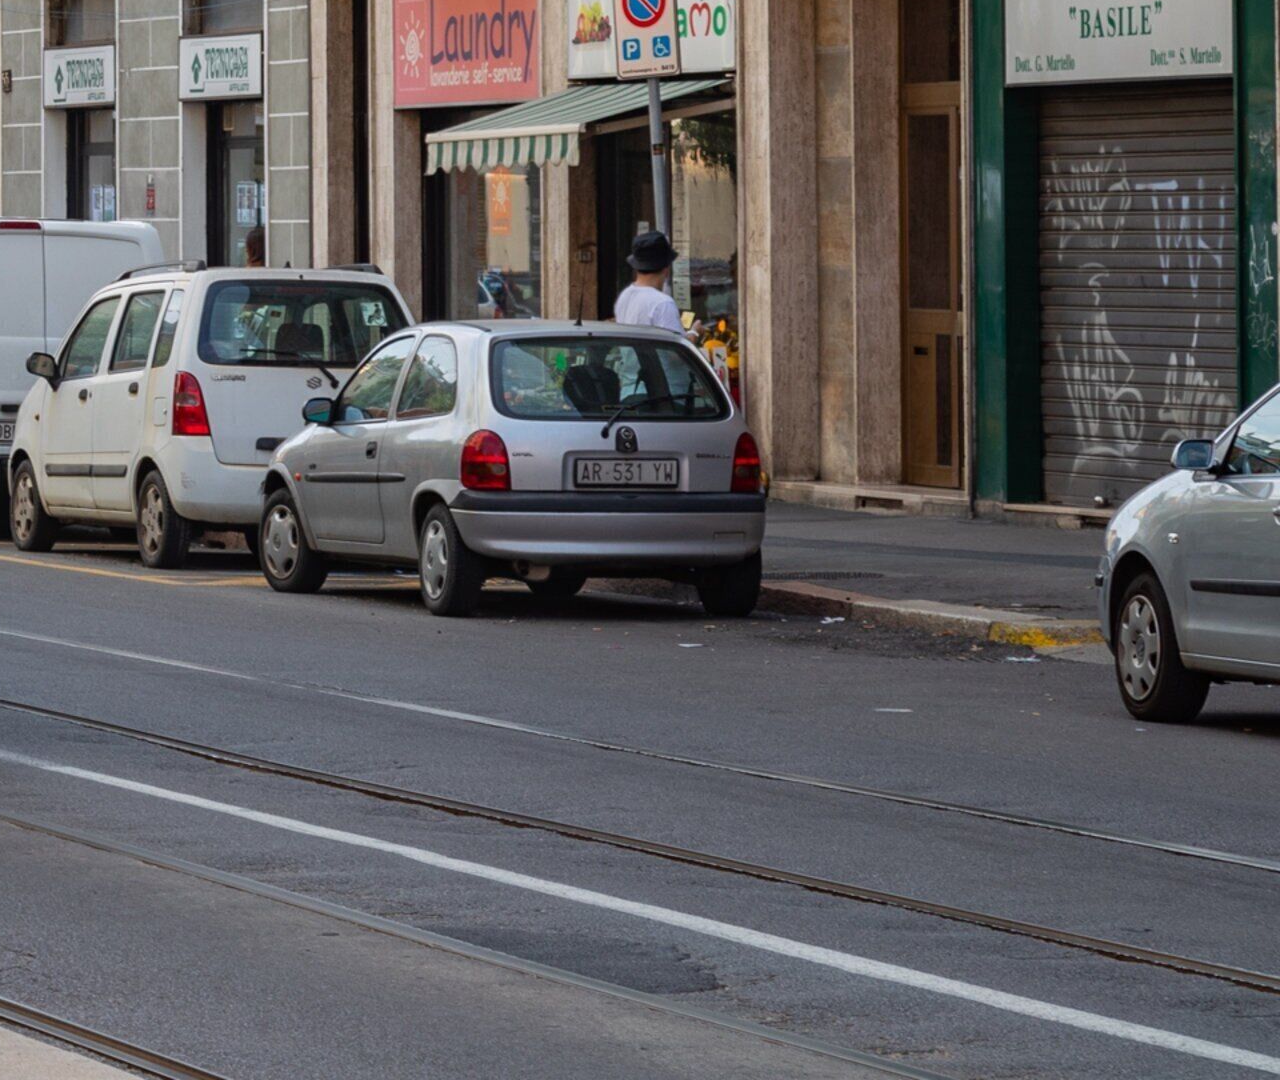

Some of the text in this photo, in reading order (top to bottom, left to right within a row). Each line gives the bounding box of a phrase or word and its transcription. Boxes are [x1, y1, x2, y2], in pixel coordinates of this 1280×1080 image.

[626, 41, 638, 58] P
[1190, 46, 1222, 65] Martello
[472, 61, 523, 85] self-service
[1015, 57, 1032, 73] Dott.
[1046, 54, 1076, 71] Martello
